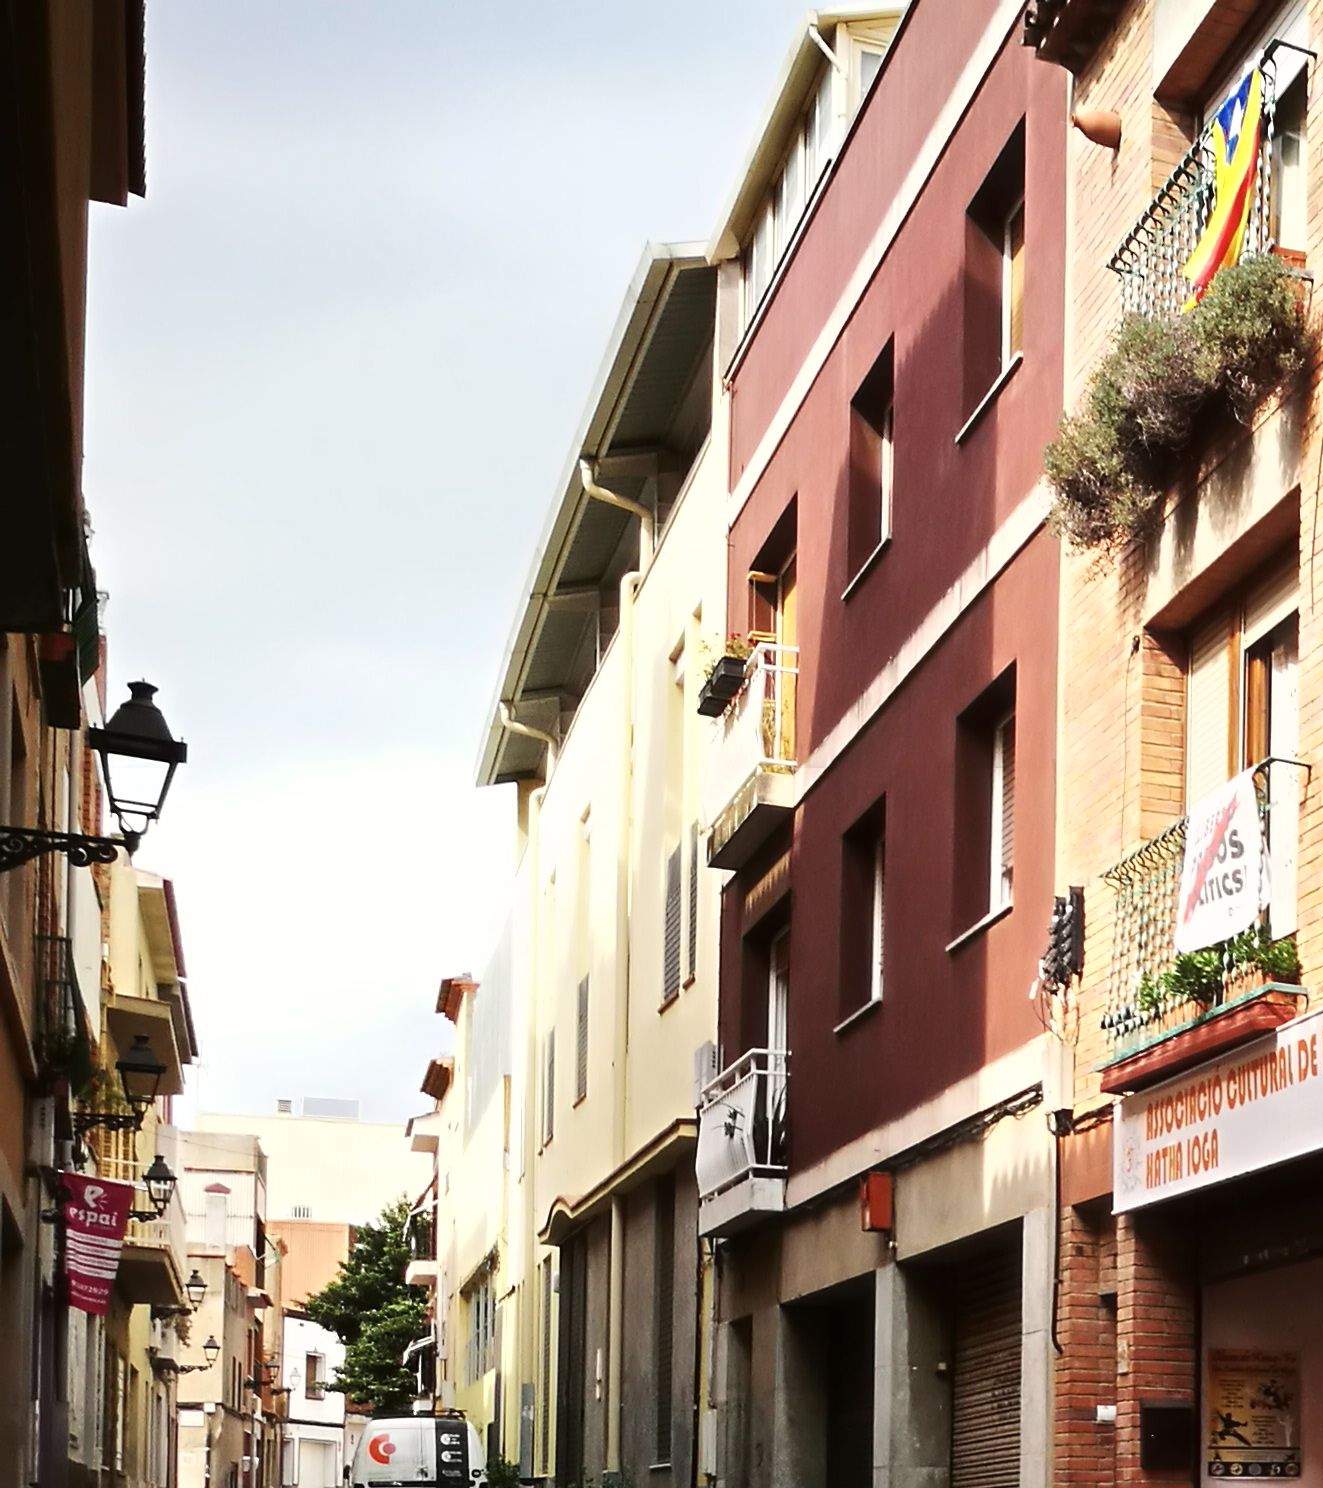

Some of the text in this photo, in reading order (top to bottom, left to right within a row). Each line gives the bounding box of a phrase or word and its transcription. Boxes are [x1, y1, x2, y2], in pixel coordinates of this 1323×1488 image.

[1145, 1066, 1223, 1141] ASSOCIACIÓ
[1226, 1043, 1294, 1110] CULTURAL
[1297, 1032, 1319, 1083] DE
[1145, 1127, 1220, 1190] HATHA IOGA
[68, 1206, 119, 1229] espai
